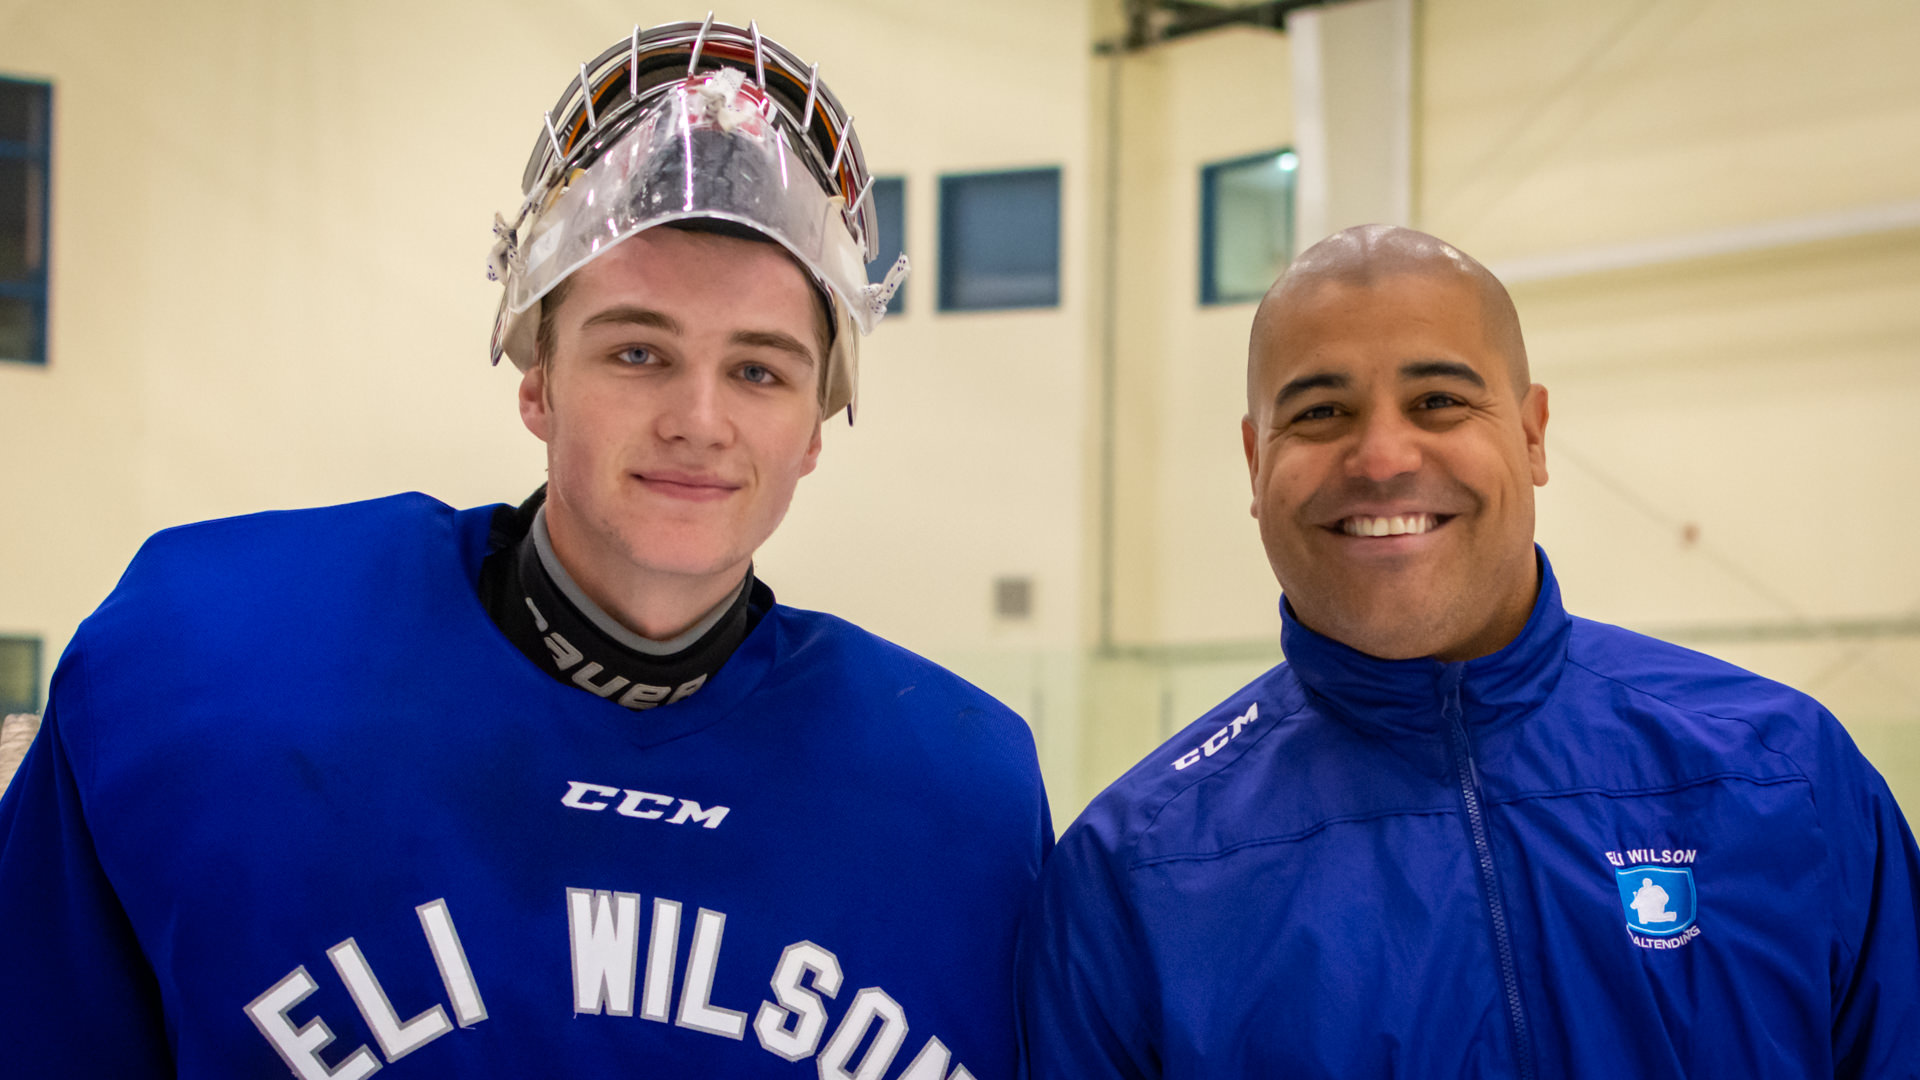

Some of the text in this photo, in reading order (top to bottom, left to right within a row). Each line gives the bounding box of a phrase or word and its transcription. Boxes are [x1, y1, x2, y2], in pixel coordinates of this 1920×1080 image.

[1171, 702, 1258, 770] CCM
[561, 781, 730, 829] CCM
[1627, 849, 1696, 863] WILSON
[243, 898, 489, 1080] ELI
